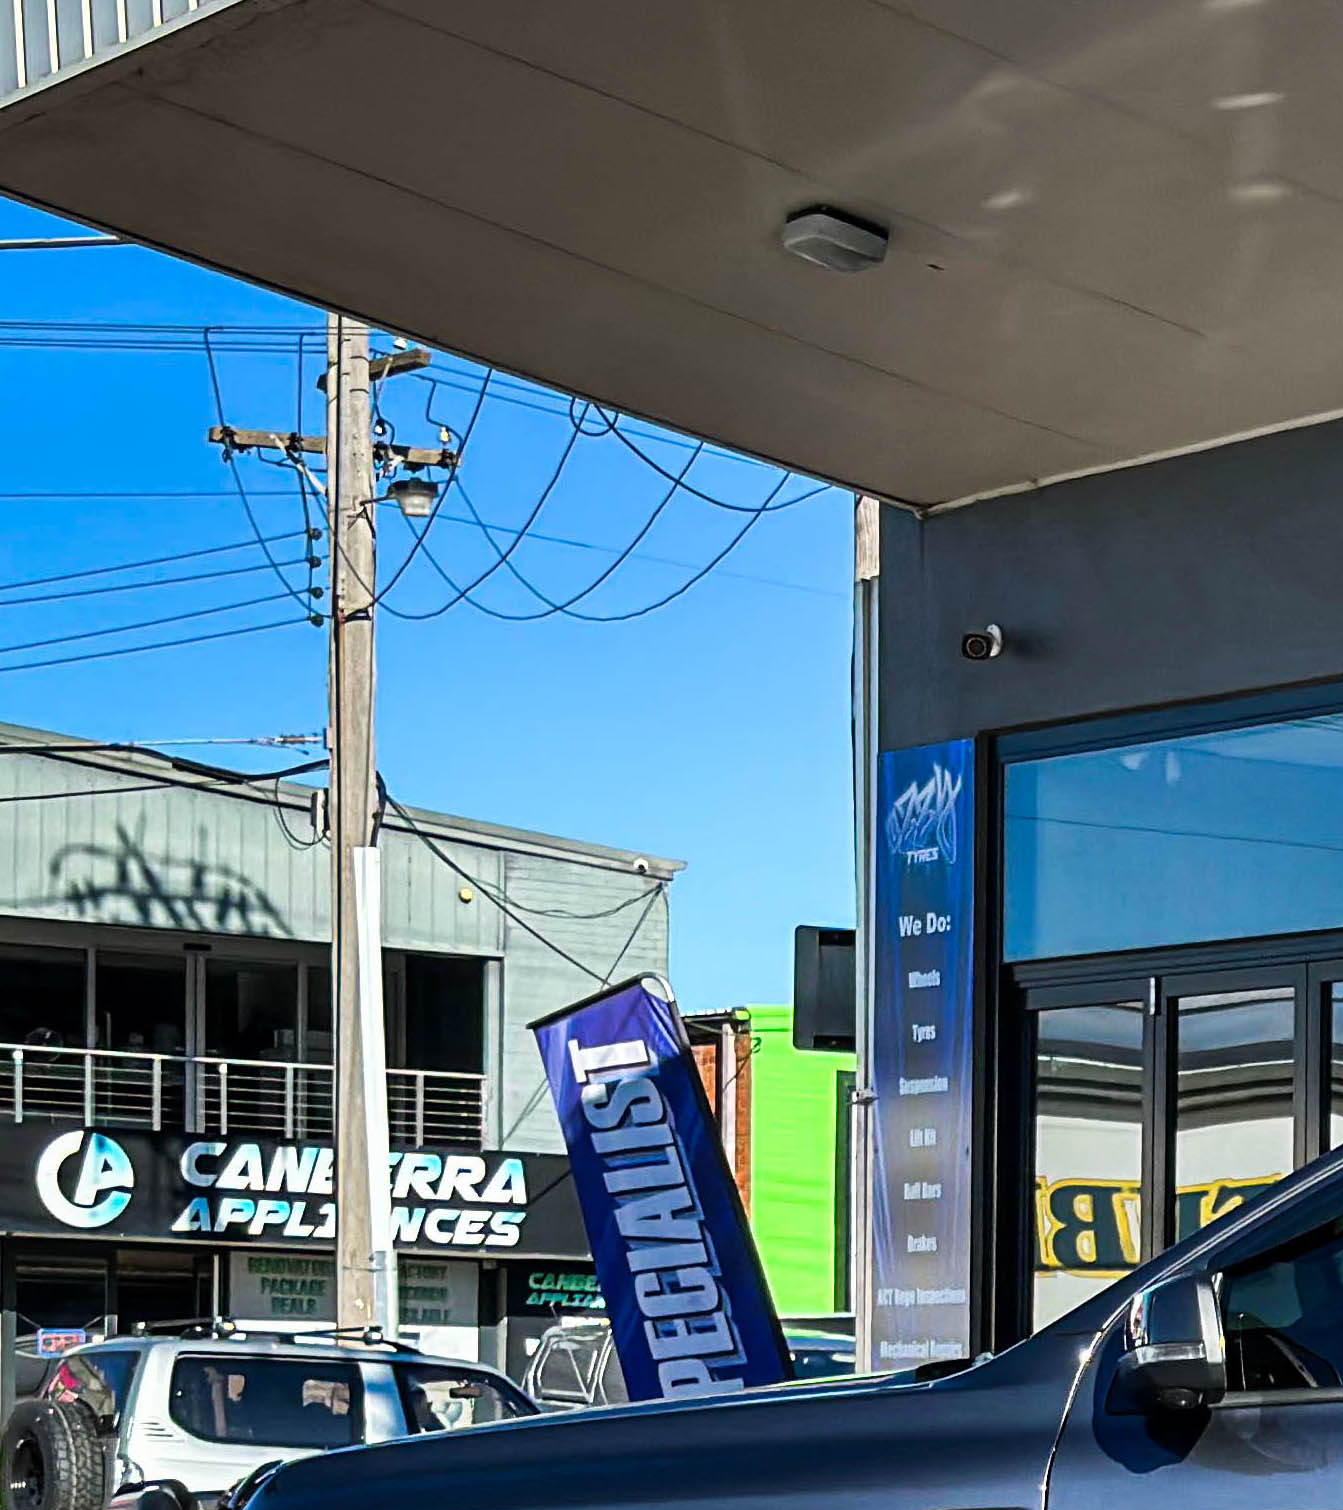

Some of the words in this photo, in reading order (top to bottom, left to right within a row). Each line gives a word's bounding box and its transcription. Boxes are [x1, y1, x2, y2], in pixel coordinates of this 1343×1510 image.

[899, 916, 921, 938] We
[926, 912, 951, 934] Do:
[912, 1024, 936, 1043] Tyres
[180, 1143, 527, 1205] CANBRRA
[172, 1198, 527, 1247] APPLINCES
